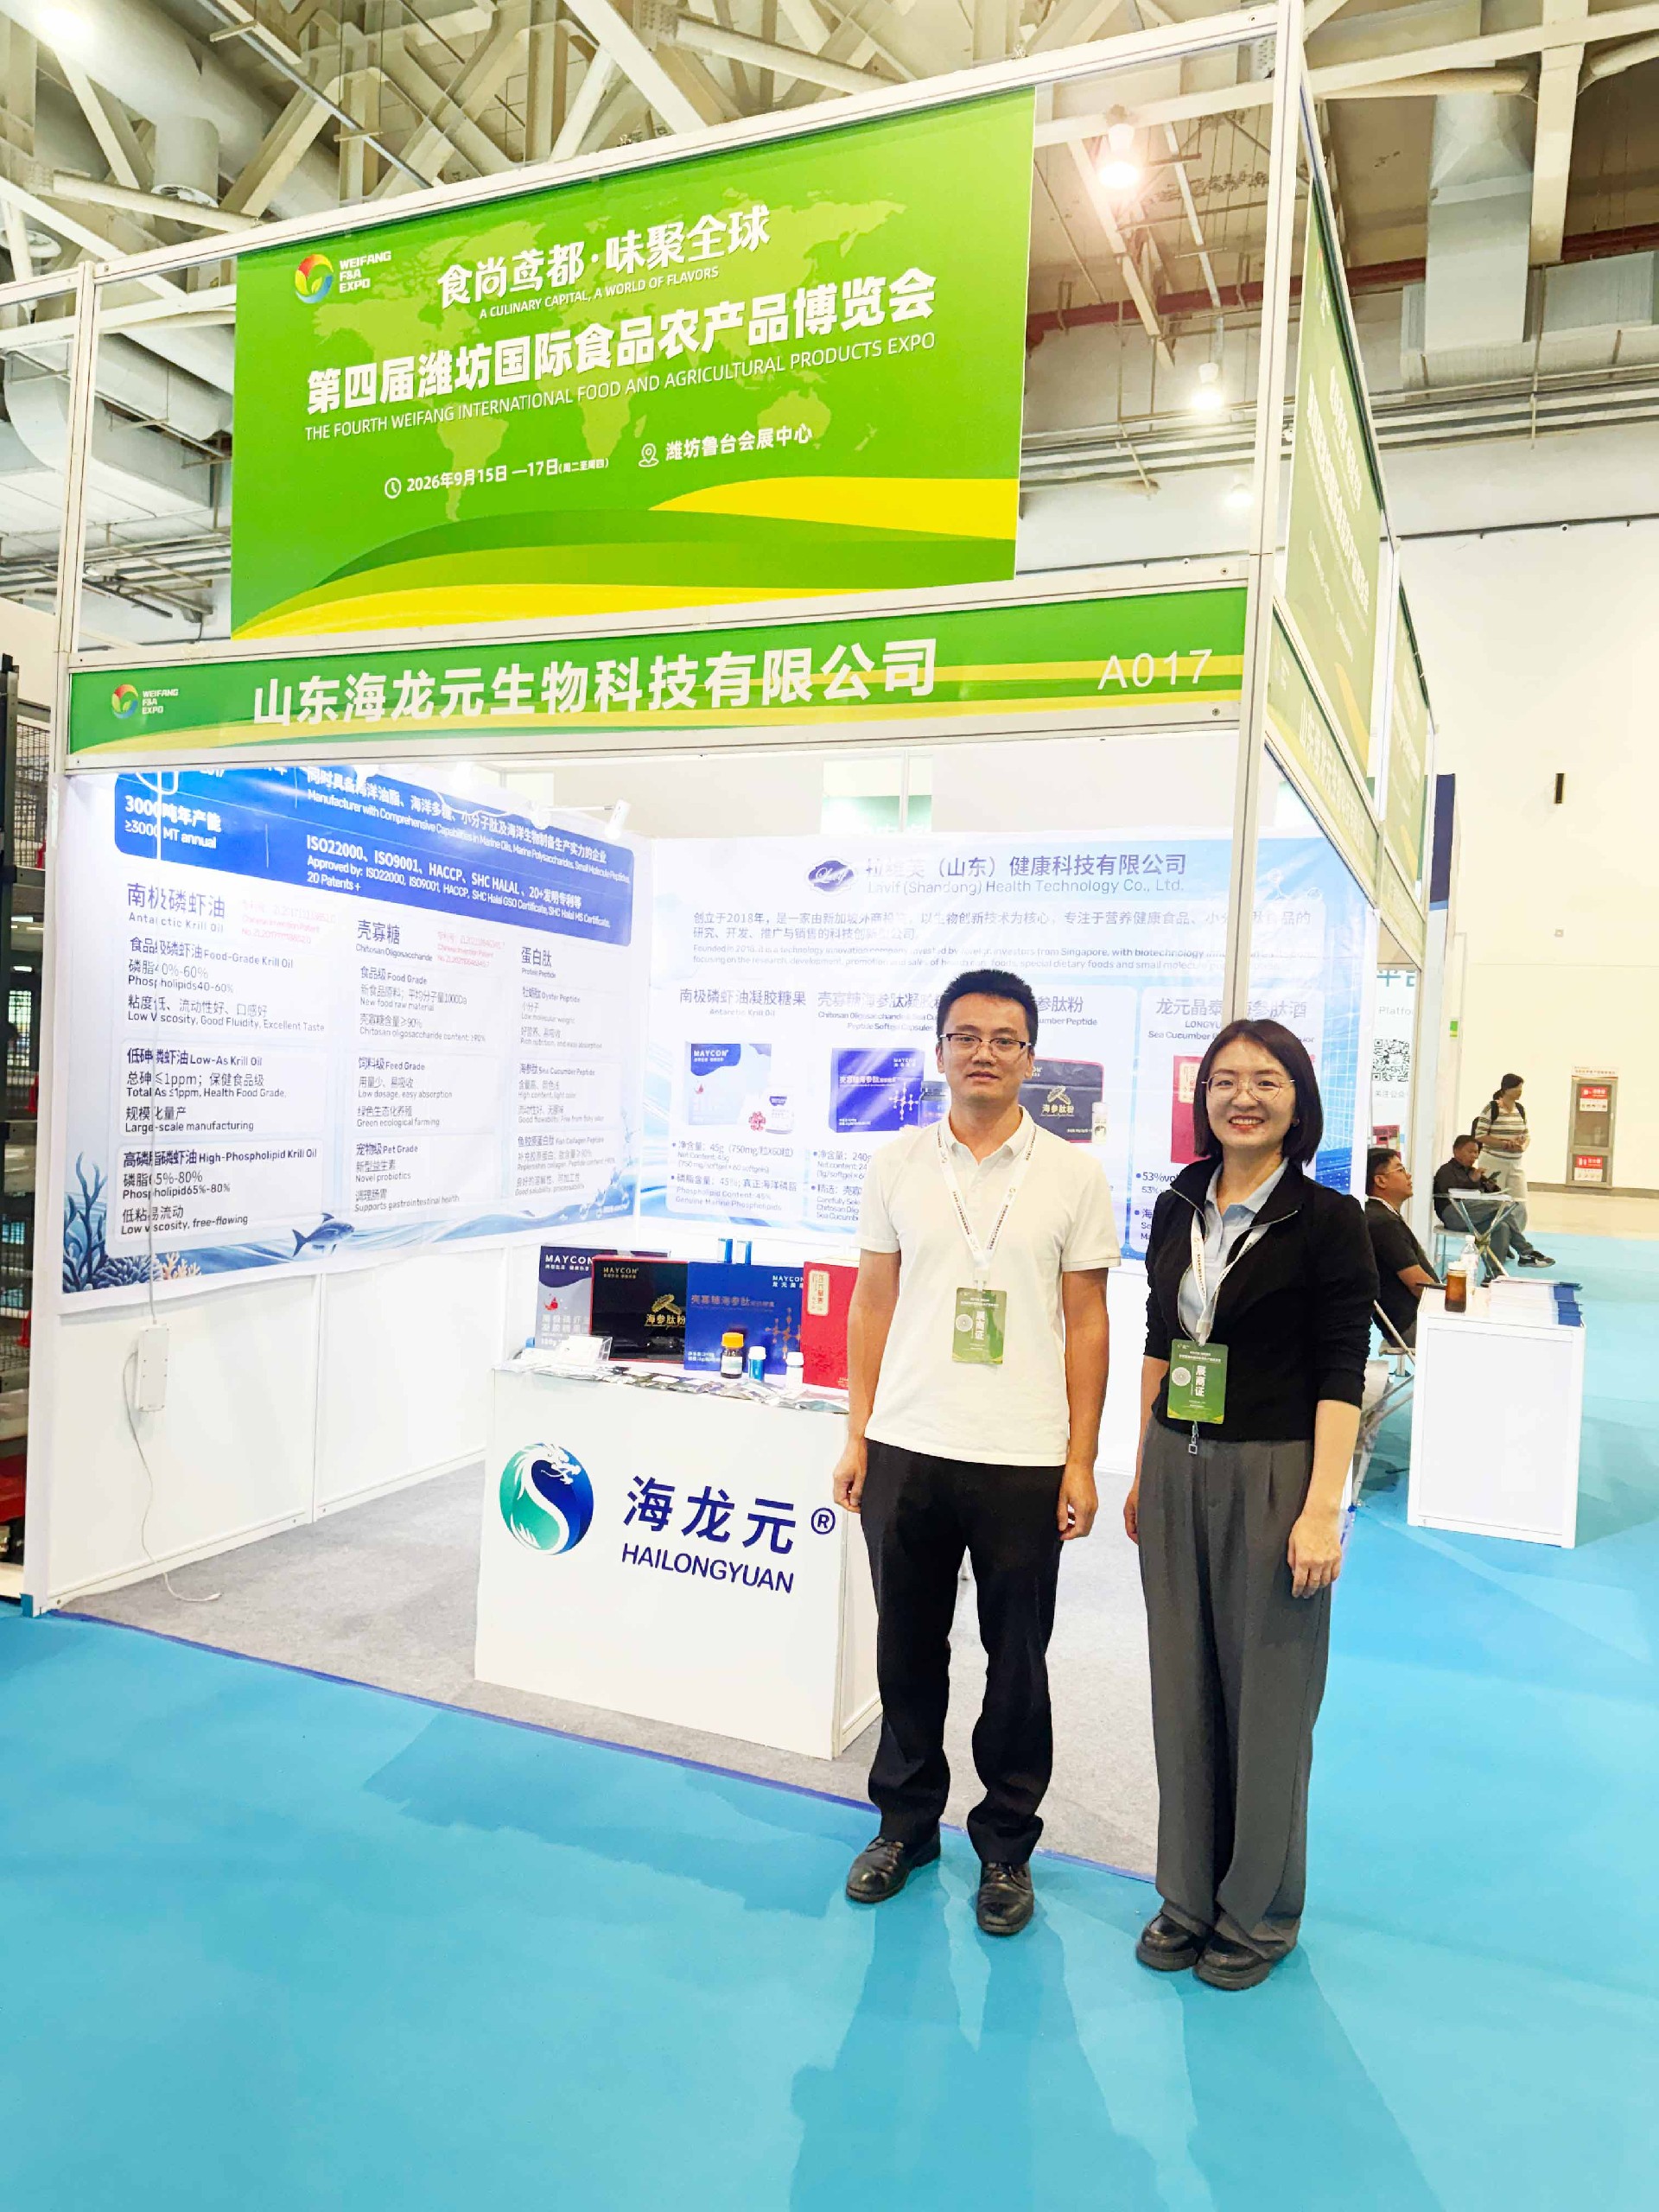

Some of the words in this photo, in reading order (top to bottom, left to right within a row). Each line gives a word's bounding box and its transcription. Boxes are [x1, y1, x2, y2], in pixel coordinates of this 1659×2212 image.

[340, 251, 391, 270] WEIFANG
[437, 205, 771, 308] 食尚鸢都·味聚全球
[340, 268, 361, 282] F&A
[340, 278, 371, 294] EXPO
[480, 308, 487, 320] A
[490, 298, 542, 318] CULINARY
[544, 291, 592, 309] CAPITAL,
[594, 289, 603, 300] A
[605, 279, 646, 297] WORLD
[648, 276, 664, 289] OF
[667, 266, 720, 286] FLAVORS
[307, 267, 937, 415] 第四届潍坊国际食品农产品博览会
[305, 424, 331, 442] THE
[334, 416, 388, 437] FOURTH
[391, 406, 454, 429] WEIFANG
[458, 390, 574, 422] INTERNATIONAL
[577, 381, 621, 401] FOOD
[625, 375, 660, 396] AND
[664, 357, 785, 389] AGRICULTURAL
[790, 340, 882, 369] PRODUCTS
[887, 331, 936, 355] EXPO
[666, 423, 812, 461] 潍坊鲁台会展中心
[1096, 648, 1213, 690] A017
[253, 639, 937, 726] 山东海龙元生物科技有限公司
[143, 689, 179, 698] WEIFANG
[143, 706, 164, 715] EXPO
[124, 795, 222, 833] 3000吨年产能
[308, 789, 363, 813] Manufacturer
[363, 804, 379, 818] with
[379, 809, 436, 832] Comprehensive
[162, 827, 180, 842] MT
[181, 830, 217, 849] annual
[308, 855, 349, 877] Approved
[351, 863, 363, 878] by:
[472, 890, 487, 902] SHC
[308, 871, 320, 883] 20
[321, 874, 354, 891] Patents
[472, 872, 490, 888] SHC
[903, 880, 982, 896] (Shandong)
[986, 879, 1031, 893] Health
[1036, 879, 1119, 895] Technology
[1123, 879, 1150, 893] Co.,
[1155, 878, 1185, 893] Ltd.
[127, 882, 226, 919] 南极磷虾油
[186, 919, 207, 931] Krill
[210, 923, 224, 934] Oil
[357, 919, 400, 945] 壳寡糖
[130, 937, 203, 960] 食品级磷虾油
[204, 951, 260, 965] Food-Grade
[262, 956, 280, 967] Krill
[281, 958, 294, 969] Oil
[355, 943, 385, 956] Chitosan
[521, 946, 552, 969] 蛋白肽
[1060, 948, 1109, 957] Singapore,
[1135, 949, 1205, 959] biotechnology
[1053, 960, 1086, 969] dietary
[1087, 960, 1114, 969] foods
[1116, 961, 1135, 969] and
[1135, 961, 1161, 969] small
[387, 972, 406, 983] Food
[407, 975, 428, 986] Grade
[359, 997, 376, 1007] New
[377, 998, 394, 1008] food
[394, 1001, 408, 1009] raw
[408, 1001, 435, 1012] material
[679, 988, 807, 1007] 南极磷虾油凝胶糖果
[1033, 995, 1084, 1014] 参肽粉
[128, 1010, 149, 1022] Low
[200, 1015, 224, 1026] Good
[226, 1017, 261, 1030] Fluidity,
[264, 1019, 302, 1032] Excellent
[303, 1021, 325, 1032] Taste
[1065, 1017, 1098, 1027] Peptide
[359, 1027, 391, 1037] Chitosan
[391, 1028, 442, 1040] oligosaccharide
[1166, 1031, 1212, 1040] Cucumber
[190, 1053, 229, 1066] Low-As
[231, 1056, 249, 1066] Krill
[251, 1057, 263, 1067] Oil
[385, 1061, 404, 1070] Feed
[404, 1062, 426, 1071] Grade
[126, 1087, 152, 1097] Total
[154, 1087, 167, 1097] As
[204, 1087, 235, 1098] Health
[236, 1087, 258, 1097] Food
[401, 1090, 417, 1101] easy
[418, 1090, 453, 1100] absorption
[125, 1105, 188, 1122] 规模化量产
[125, 1122, 184, 1134] Large-scale
[186, 1121, 254, 1133] manufacturing
[357, 1119, 378, 1128] Green
[379, 1118, 414, 1128] ecological
[414, 1117, 440, 1128] farming
[199, 1149, 286, 1164] High-Phospholipid
[287, 1148, 304, 1160] Krill
[306, 1147, 317, 1158] Oil
[383, 1145, 397, 1154] Pet
[397, 1144, 418, 1154] Grade
[355, 1173, 376, 1183] Novel
[376, 1172, 412, 1183] probiotics
[354, 1200, 387, 1213] Supports
[388, 1197, 441, 1211] gastrointestinal
[441, 1194, 460, 1205] health
[121, 1224, 142, 1236] Low
[144, 1217, 191, 1234] vscosity,
[193, 1214, 249, 1228] free-flowing
[544, 1254, 593, 1265] MAYCON
[645, 1313, 686, 1326] 海参肽粉
[623, 1475, 797, 1554] 海龙元
[621, 1542, 794, 1593] HAILONGYUAN
